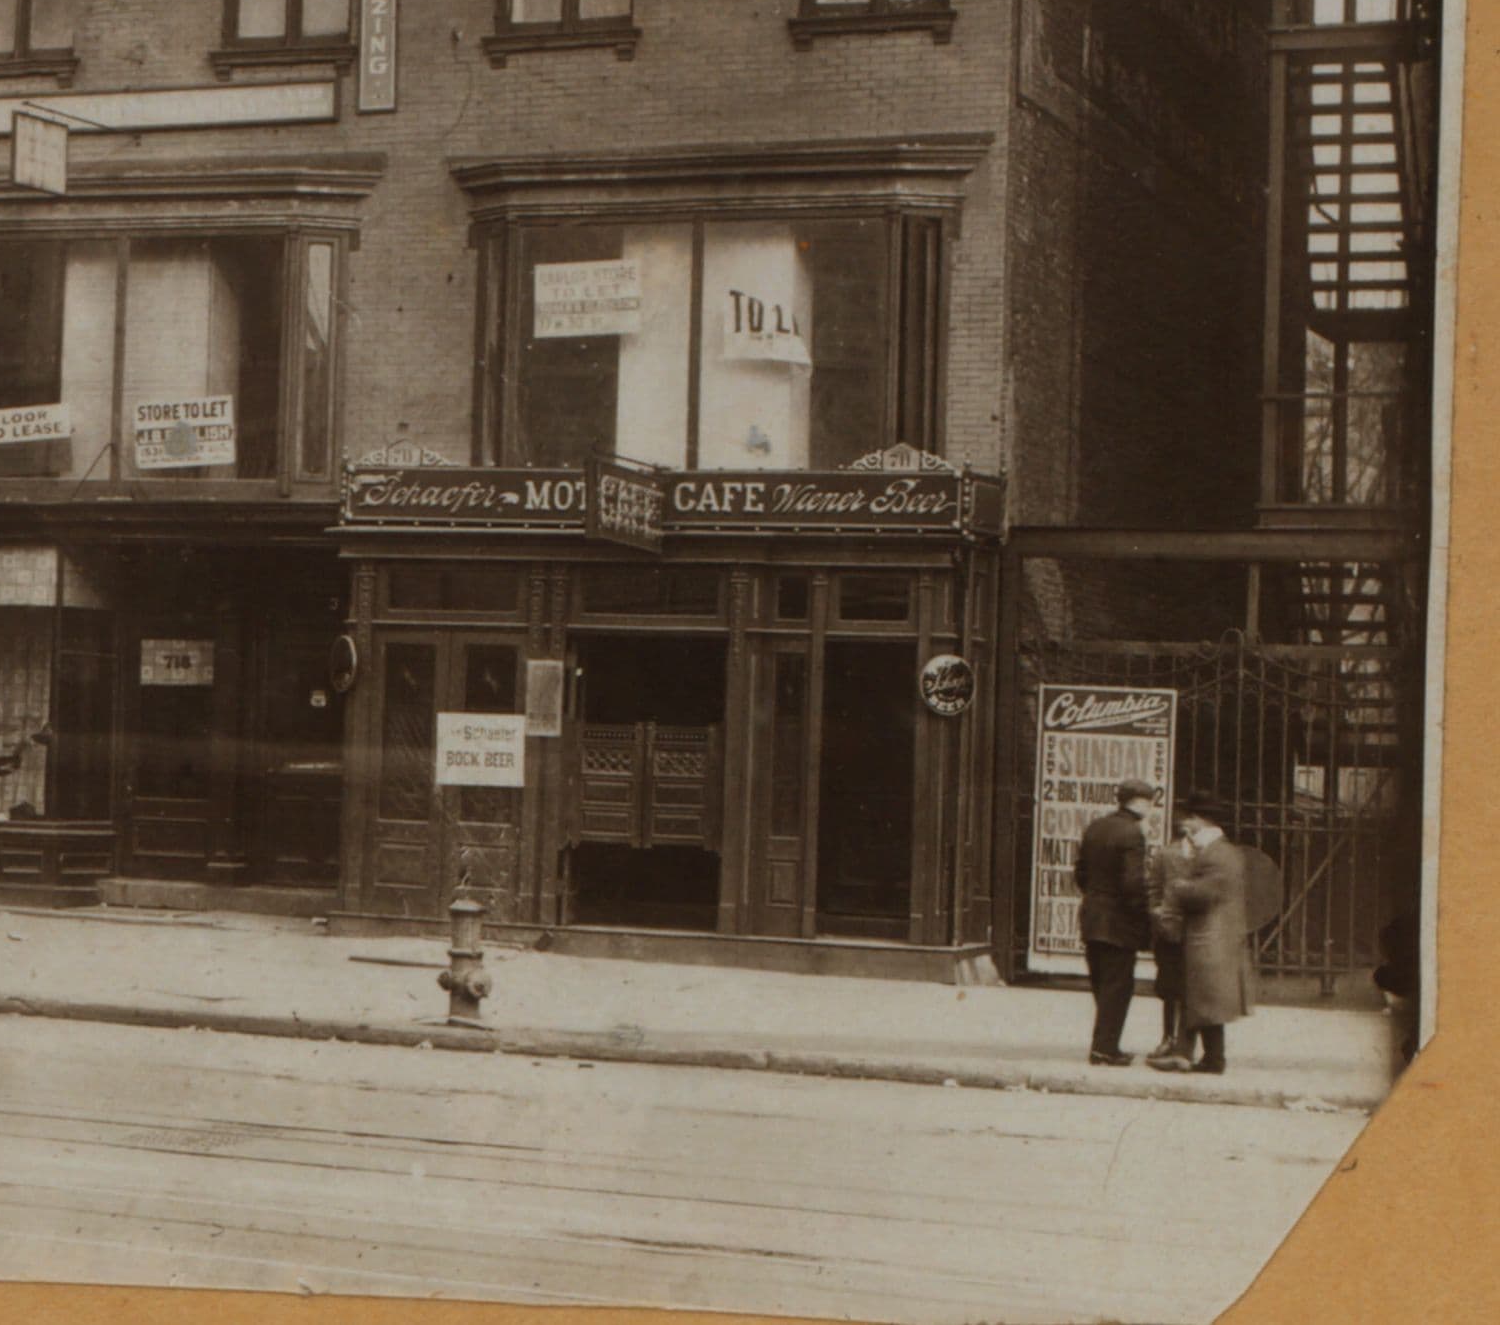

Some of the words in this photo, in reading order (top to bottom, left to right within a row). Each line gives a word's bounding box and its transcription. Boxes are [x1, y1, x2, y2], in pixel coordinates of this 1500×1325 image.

[729, 289, 765, 334] TO
[137, 403, 180, 422] STORE
[183, 402, 200, 419] TO
[202, 399, 228, 418] LET
[11, 421, 63, 437] LEASE
[353, 471, 502, 514] Schaefer
[672, 480, 766, 513] CAFE
[771, 483, 869, 514] Wiener
[868, 477, 956, 514] Beer
[1046, 692, 1162, 727] Columbia
[445, 750, 480, 767] BOCK
[484, 751, 515, 768] BEER
[1059, 737, 1152, 779] SUNDAY
[1081, 781, 1118, 805] VAUDE
[1042, 837, 1081, 866] MATI
[1041, 870, 1082, 897] EVEN
[1056, 902, 1082, 936] STA
